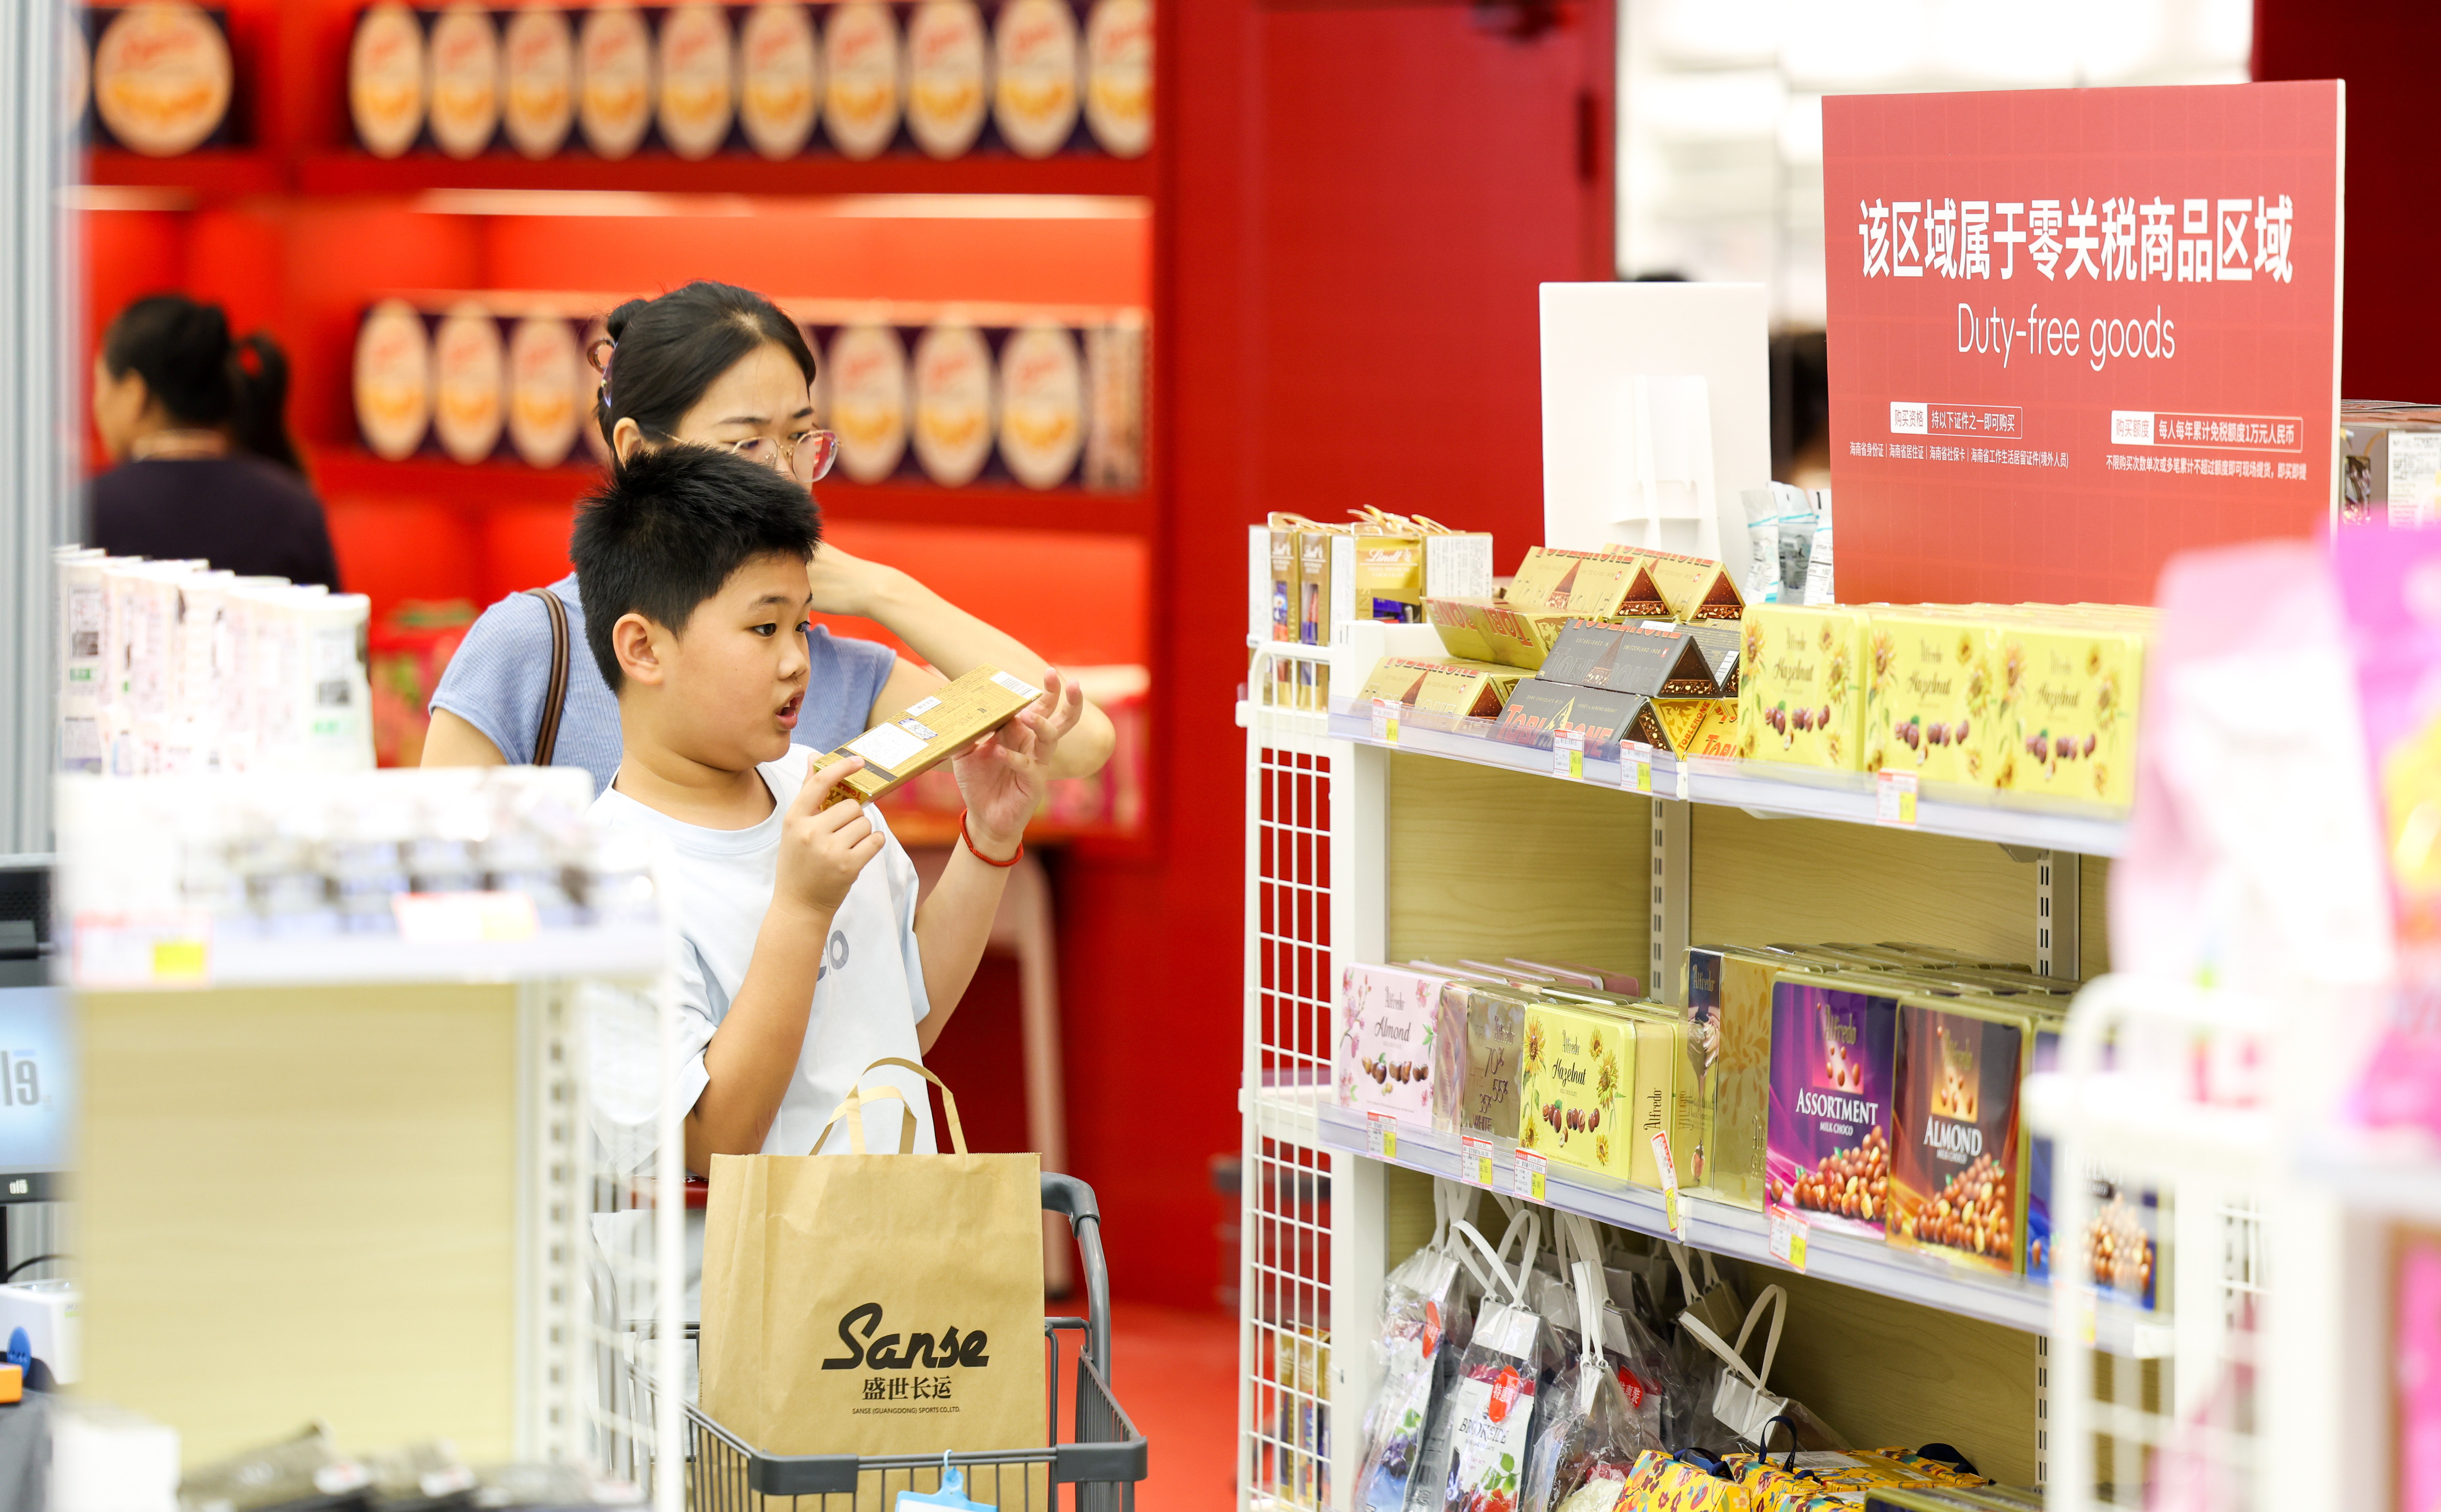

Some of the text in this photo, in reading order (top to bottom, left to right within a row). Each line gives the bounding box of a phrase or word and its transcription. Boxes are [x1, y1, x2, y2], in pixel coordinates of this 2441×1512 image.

[1859, 194, 2294, 283] 该区域属于零关税商品区域
[1958, 303, 2175, 371] Duty-free goods
[1895, 410, 1924, 428] 购买资格
[1931, 410, 2015, 432] 持以下证件之一即可购买
[2116, 419, 2149, 438] 购买额度
[2159, 419, 2294, 445] 每人每年累计免税额度1万元人民币
[1850, 441, 2069, 469] 海南省身份证 海南省居住证 海南省社保卡 海南省工作生活居留证件(境外人员)
[1366, 549, 1403, 562] Lindt
[1575, 638, 1602, 646] ESTABLISHED
[1623, 644, 1649, 652] SWITZERLAND
[1677, 701, 1710, 751] TOBLERONE
[1571, 756, 1582, 765] 180.00
[1693, 964, 1714, 992] Alfredo
[1385, 986, 1405, 1011] Alfredo
[1375, 1016, 1411, 1042] Almond
[1824, 1004, 1857, 1045] Alfredo
[1562, 1030, 1579, 1055] Alfredo
[1485, 1046, 1504, 1077] 70%
[1552, 1058, 1586, 1087] Hazelnut
[1479, 1093, 1492, 1113] 35%
[1492, 1078, 1508, 1103] 55%
[1643, 1090, 1662, 1130] Alfredo
[1795, 1087, 1879, 1126] ASSORTMENT
[1473, 1114, 1492, 1132] WHITE
[1819, 1121, 1854, 1136] MILK CHOCO
[1923, 1115, 1983, 1157] ALMOND
[1532, 1179, 1541, 1189] 98.00
[821, 1302, 990, 1370] Sanse
[862, 1375, 952, 1401] 盛世长运
[1458, 1418, 1509, 1444] BROOKSIDE
